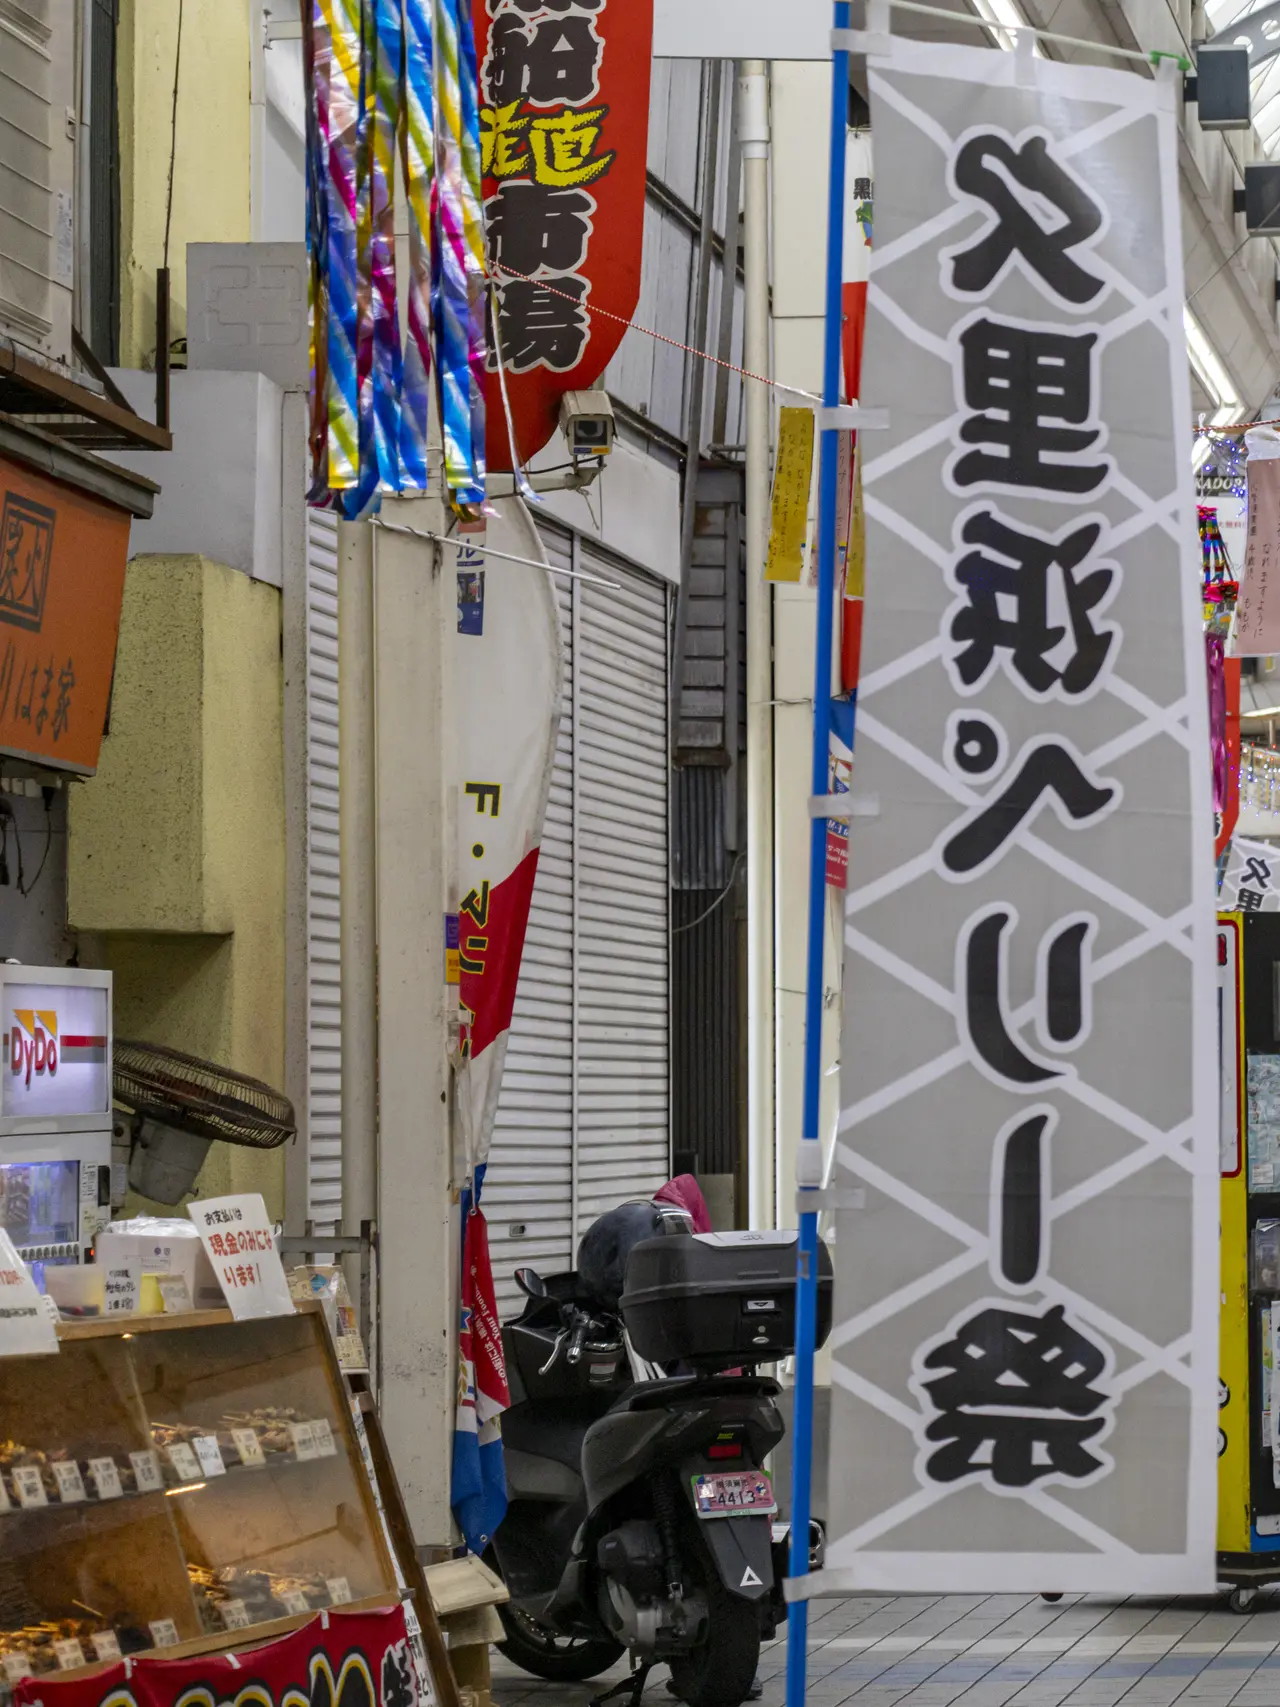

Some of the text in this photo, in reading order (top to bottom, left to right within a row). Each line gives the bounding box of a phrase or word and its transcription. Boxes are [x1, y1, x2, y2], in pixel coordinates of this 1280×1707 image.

[926, 134, 1112, 1490] 久里浜ペリー祭
[11, 1026, 58, 1088] DyDo
[203, 1208, 243, 1226] お支払いは
[207, 1228, 274, 1257] 現金のみにな
